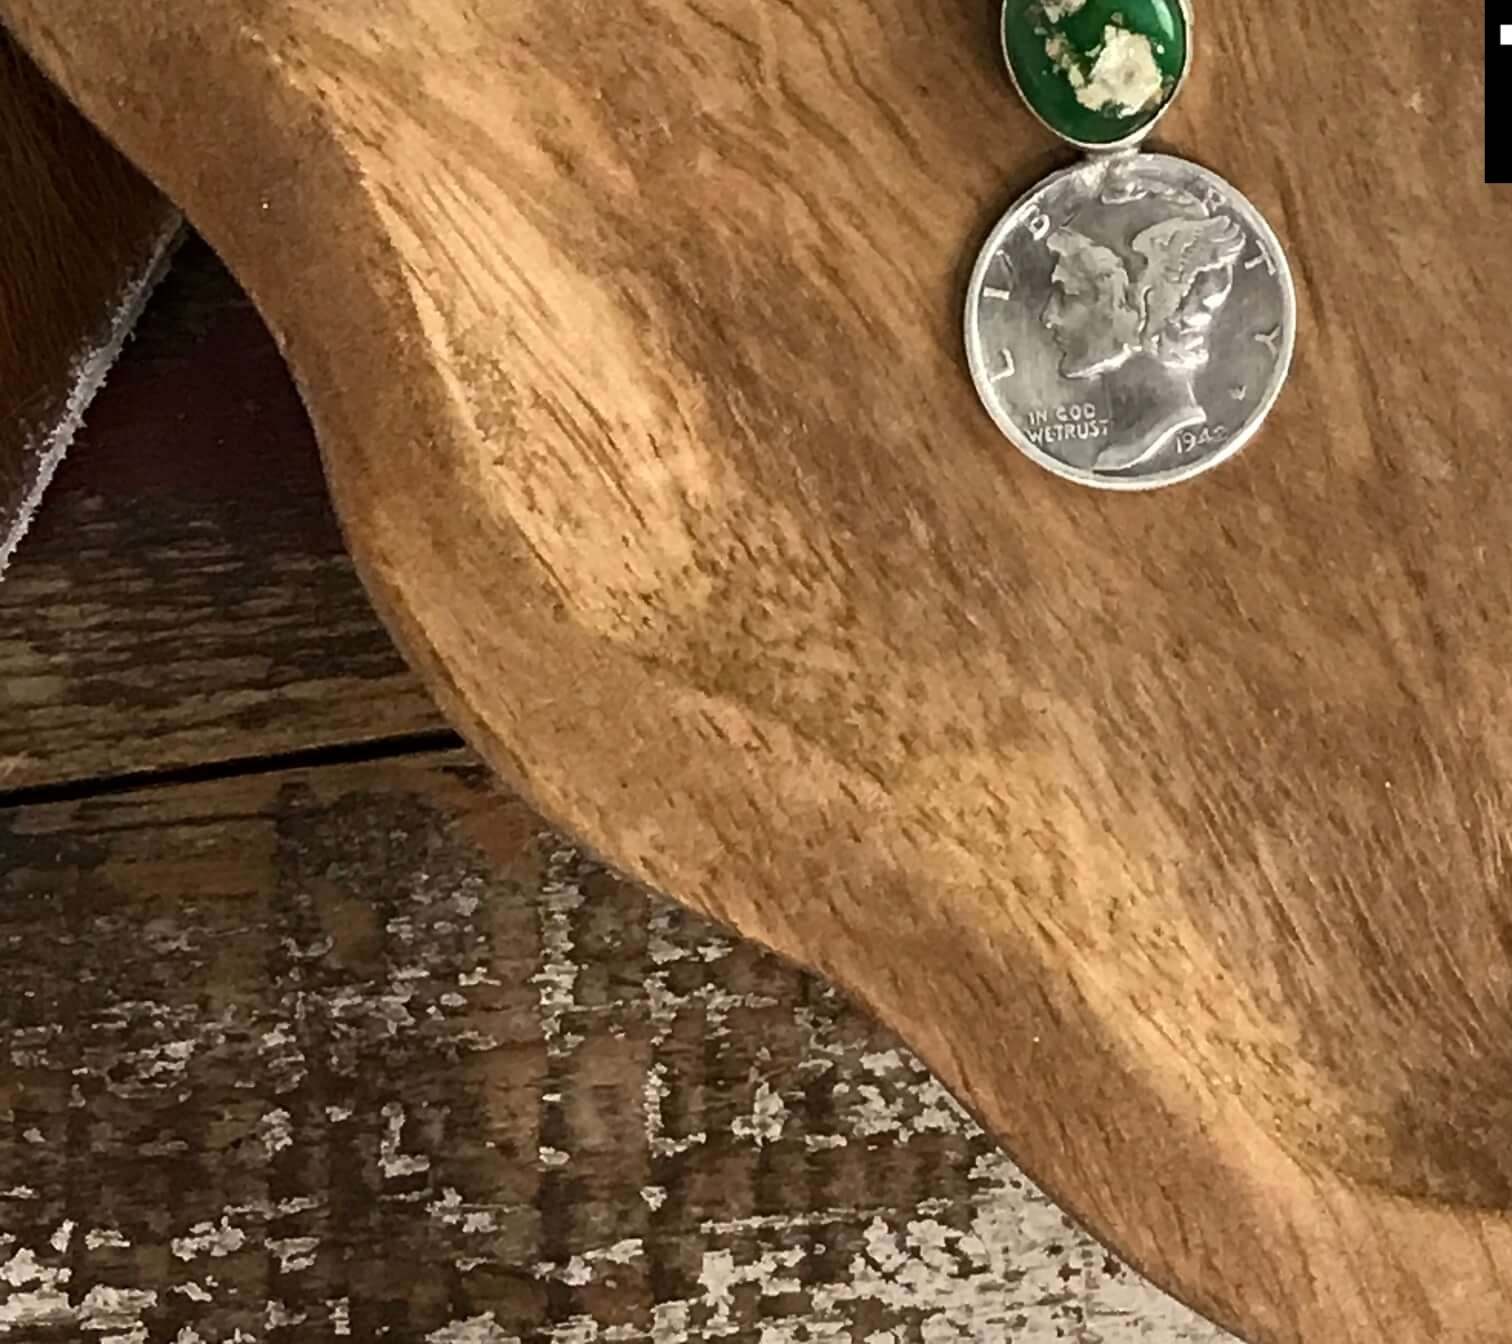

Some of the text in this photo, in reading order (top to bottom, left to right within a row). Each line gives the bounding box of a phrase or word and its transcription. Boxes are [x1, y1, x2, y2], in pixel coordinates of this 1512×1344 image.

[983, 174, 1281, 382] LIBRTY
[1028, 409, 1048, 424] IN
[1055, 419, 1109, 441] TRUST
